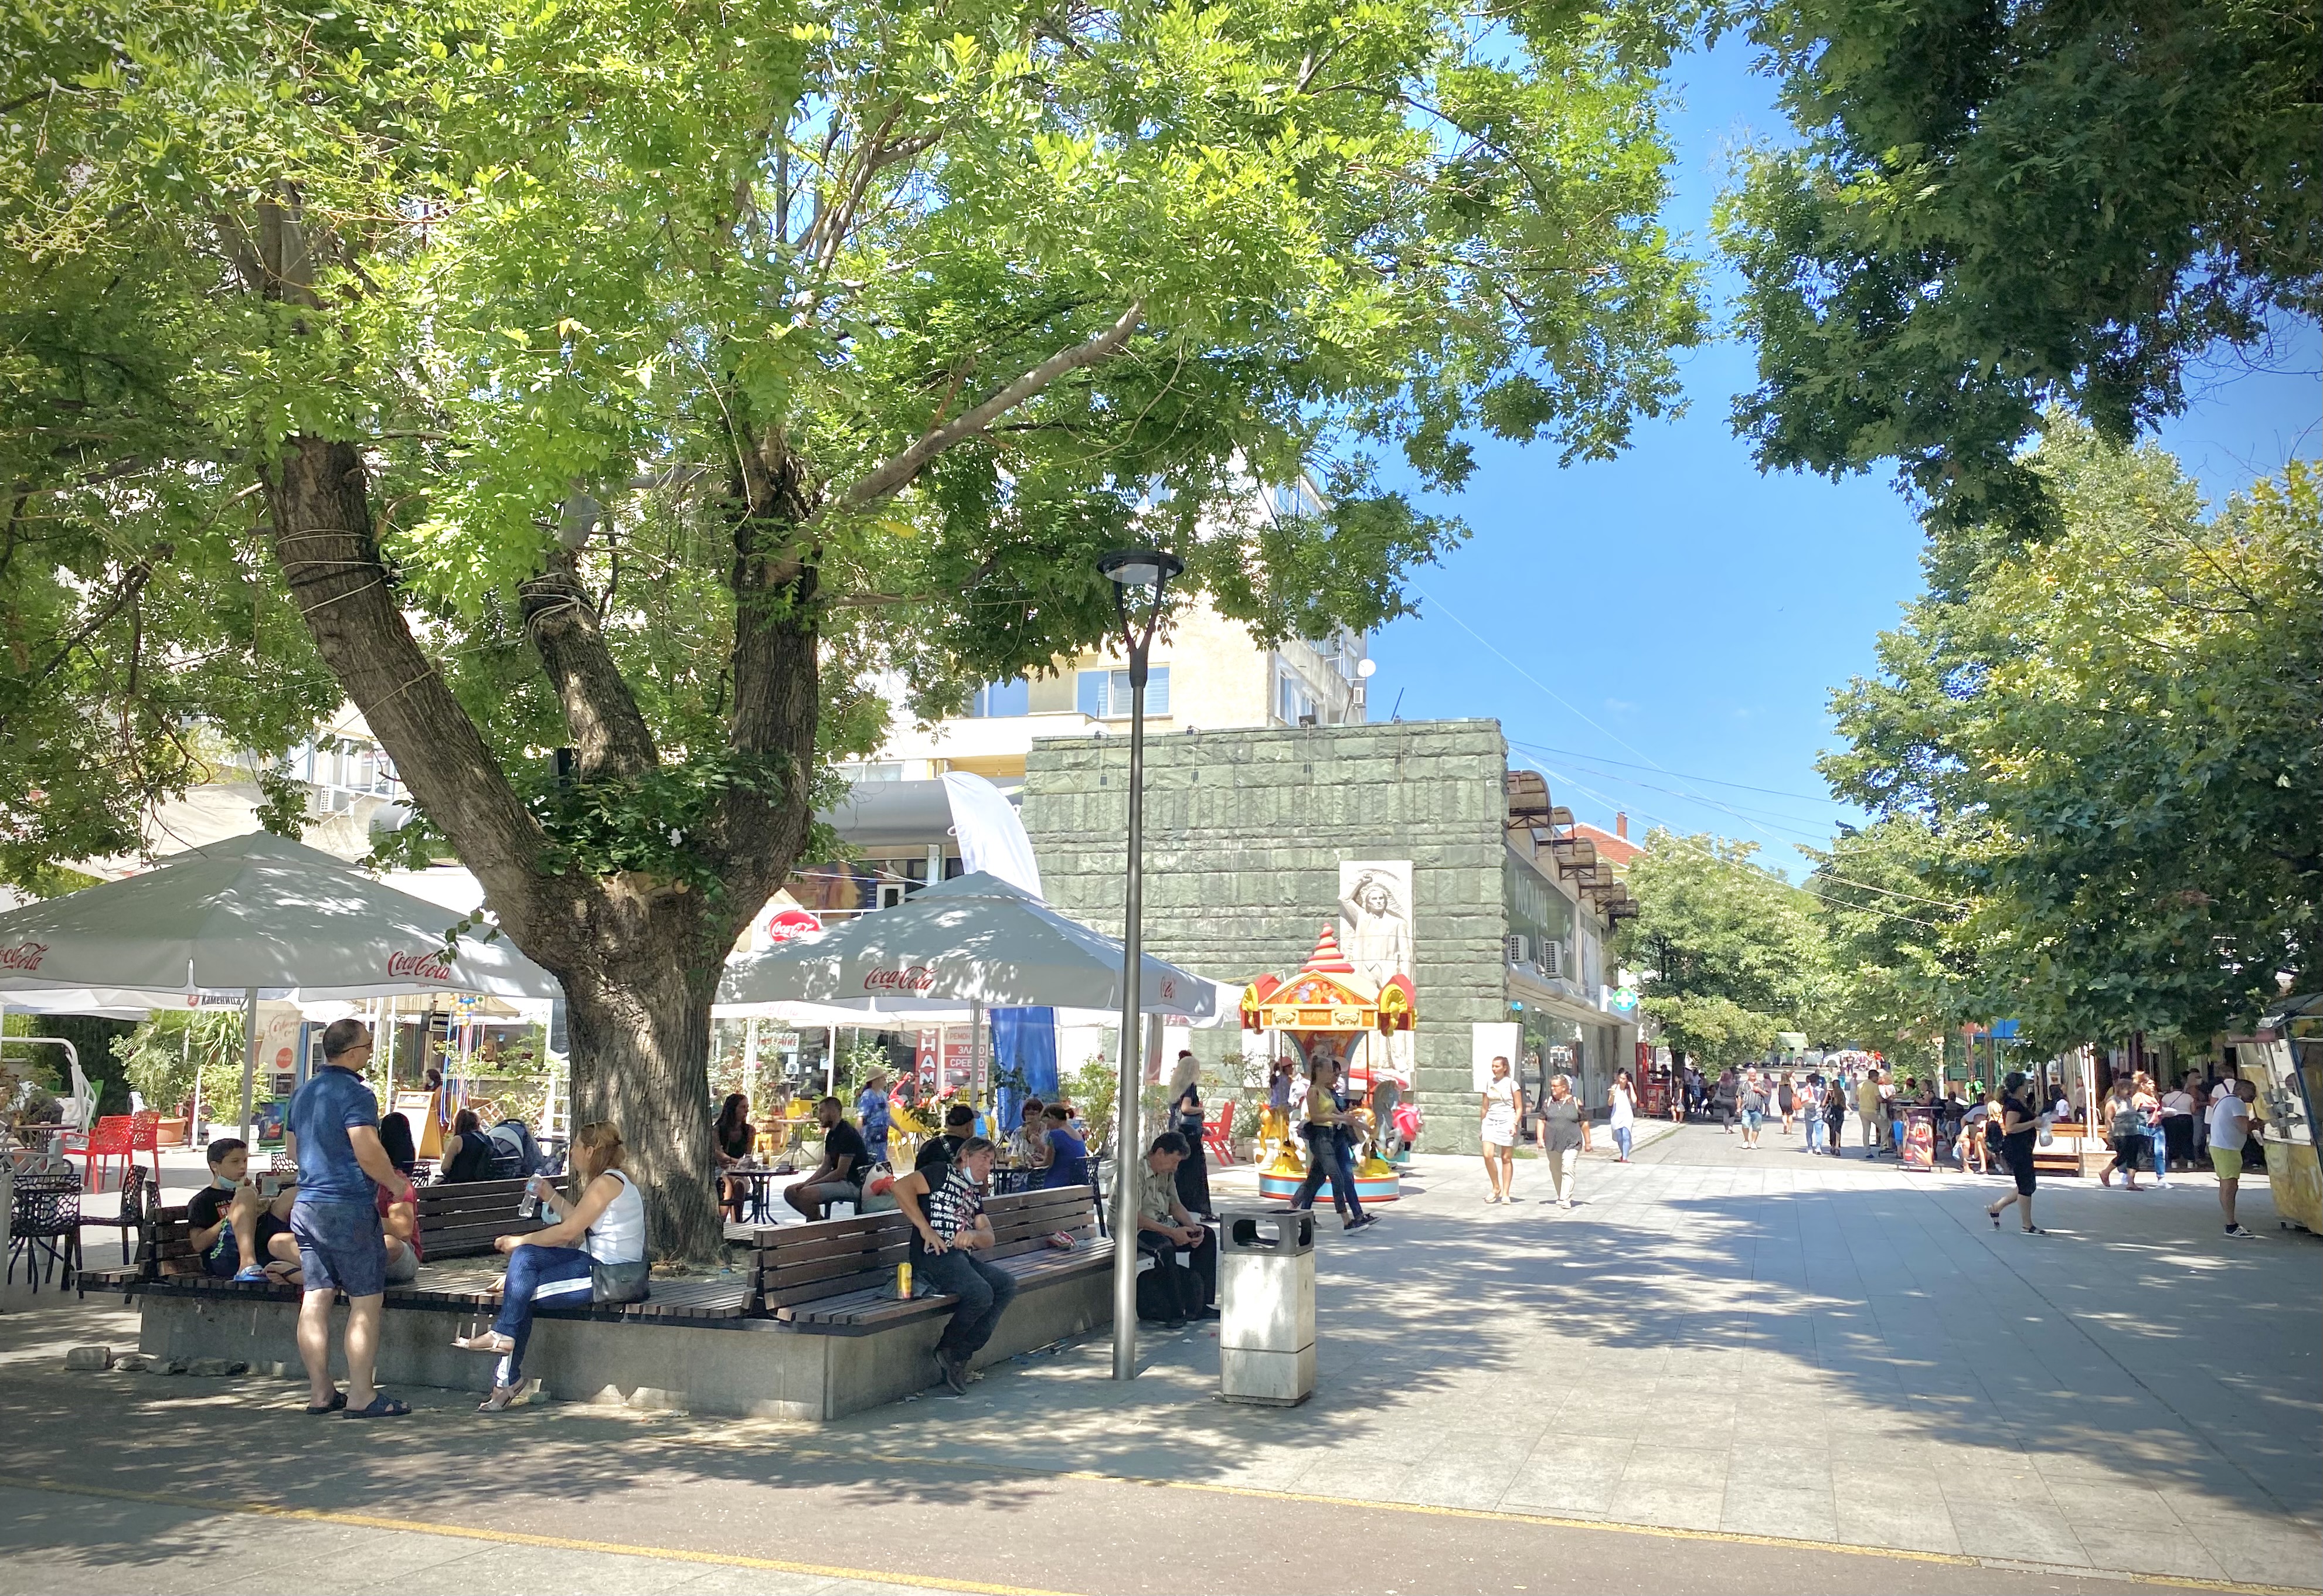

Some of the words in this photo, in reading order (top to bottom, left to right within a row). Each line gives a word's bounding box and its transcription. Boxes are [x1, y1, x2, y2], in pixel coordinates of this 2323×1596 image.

[387, 951, 451, 980] Coca-Cola
[863, 966, 939, 990] Coca-Cola
[958, 1046, 985, 1054] ЗЛАО
[950, 1059, 985, 1067] СРЕБО
